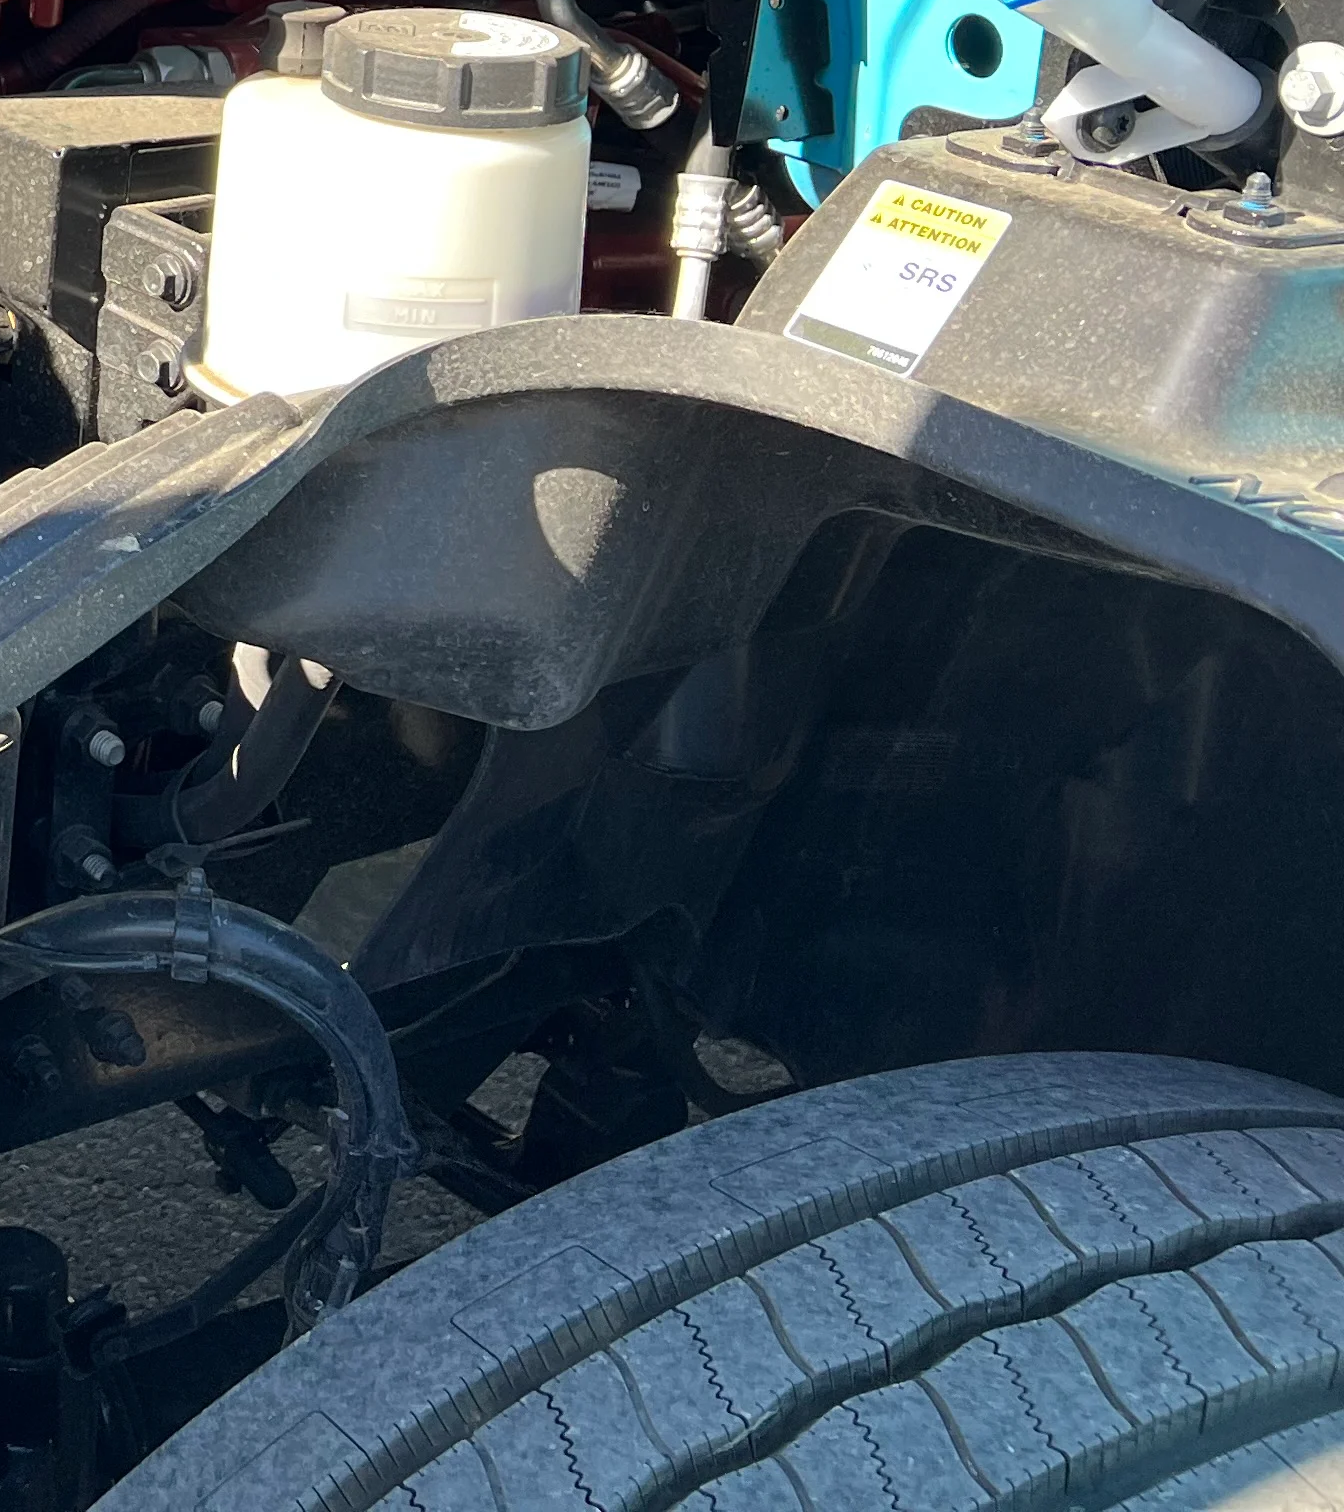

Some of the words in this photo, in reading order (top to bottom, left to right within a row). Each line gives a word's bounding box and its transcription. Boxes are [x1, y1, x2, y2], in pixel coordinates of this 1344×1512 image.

[911, 200, 987, 229] CAUTION
[888, 218, 981, 253] ATTENTION
[899, 262, 957, 293] SRS
[395, 308, 436, 324] MIN
